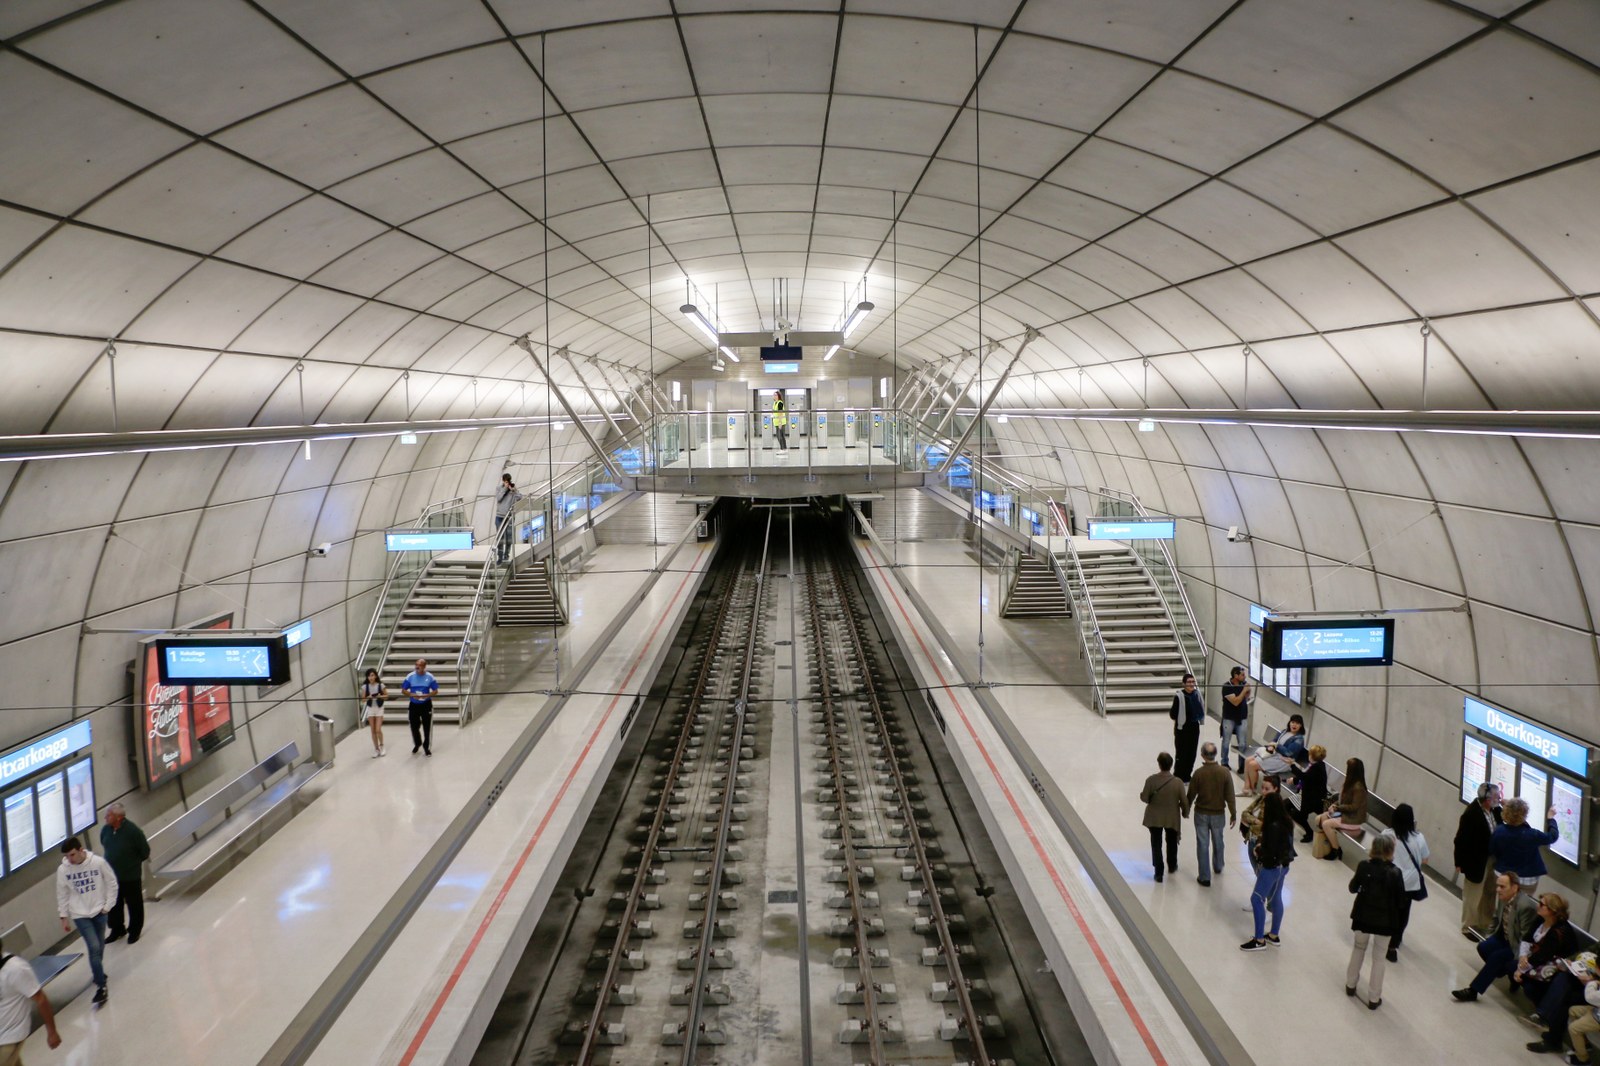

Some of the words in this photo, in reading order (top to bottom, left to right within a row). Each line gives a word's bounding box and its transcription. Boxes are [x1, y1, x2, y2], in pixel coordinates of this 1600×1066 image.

[1313, 631, 1321, 644] 2
[169, 650, 177, 662] 1
[1486, 709, 1560, 759] Otxarkoaga
[90, 869, 99, 877] IS
[74, 884, 96, 895] AKE
